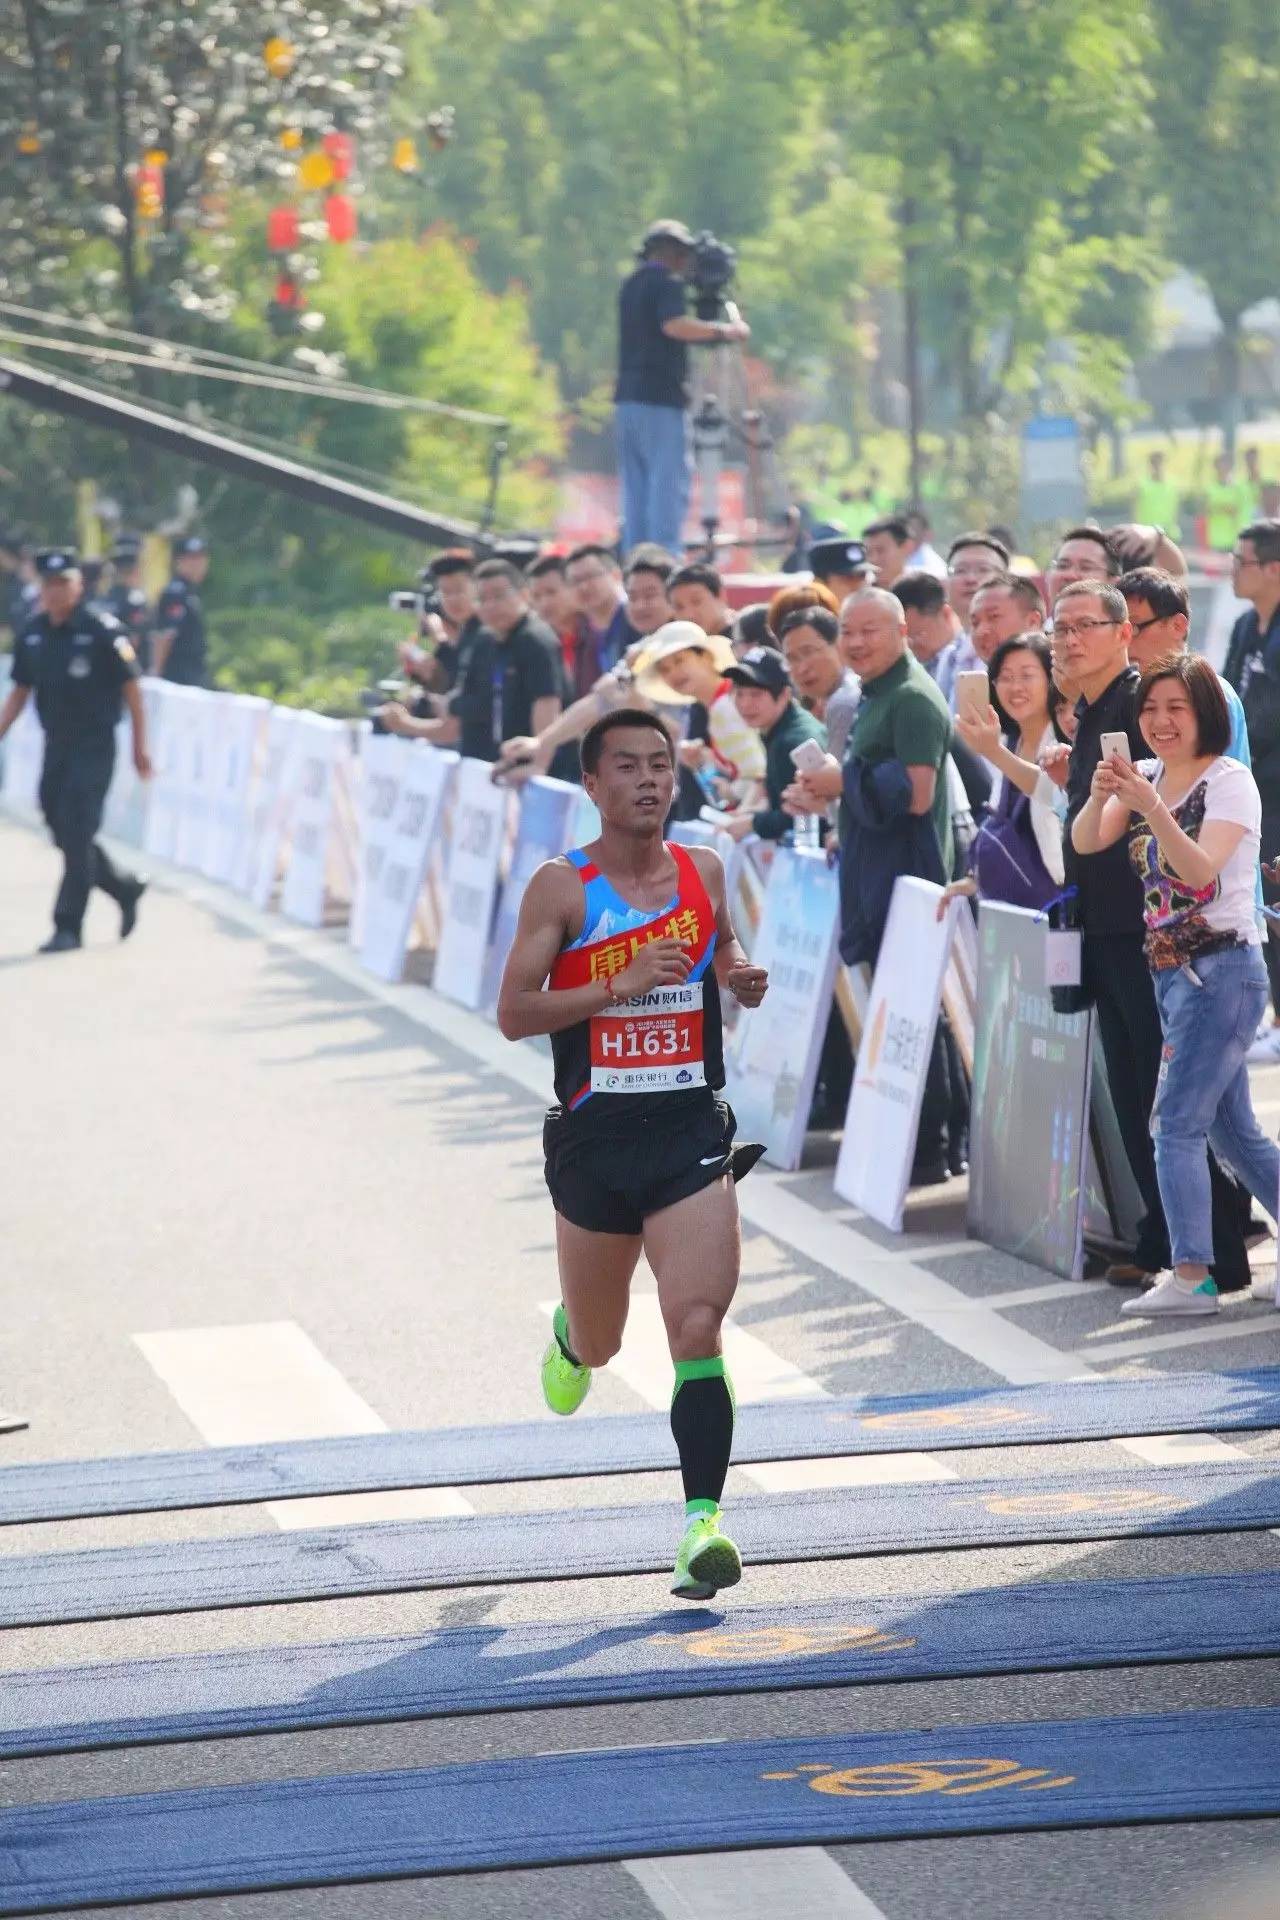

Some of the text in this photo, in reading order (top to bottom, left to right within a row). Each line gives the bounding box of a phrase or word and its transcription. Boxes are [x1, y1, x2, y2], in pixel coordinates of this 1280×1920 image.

[601, 1027, 691, 1057] H1631
[624, 1073, 667, 1084] 重庆银行
